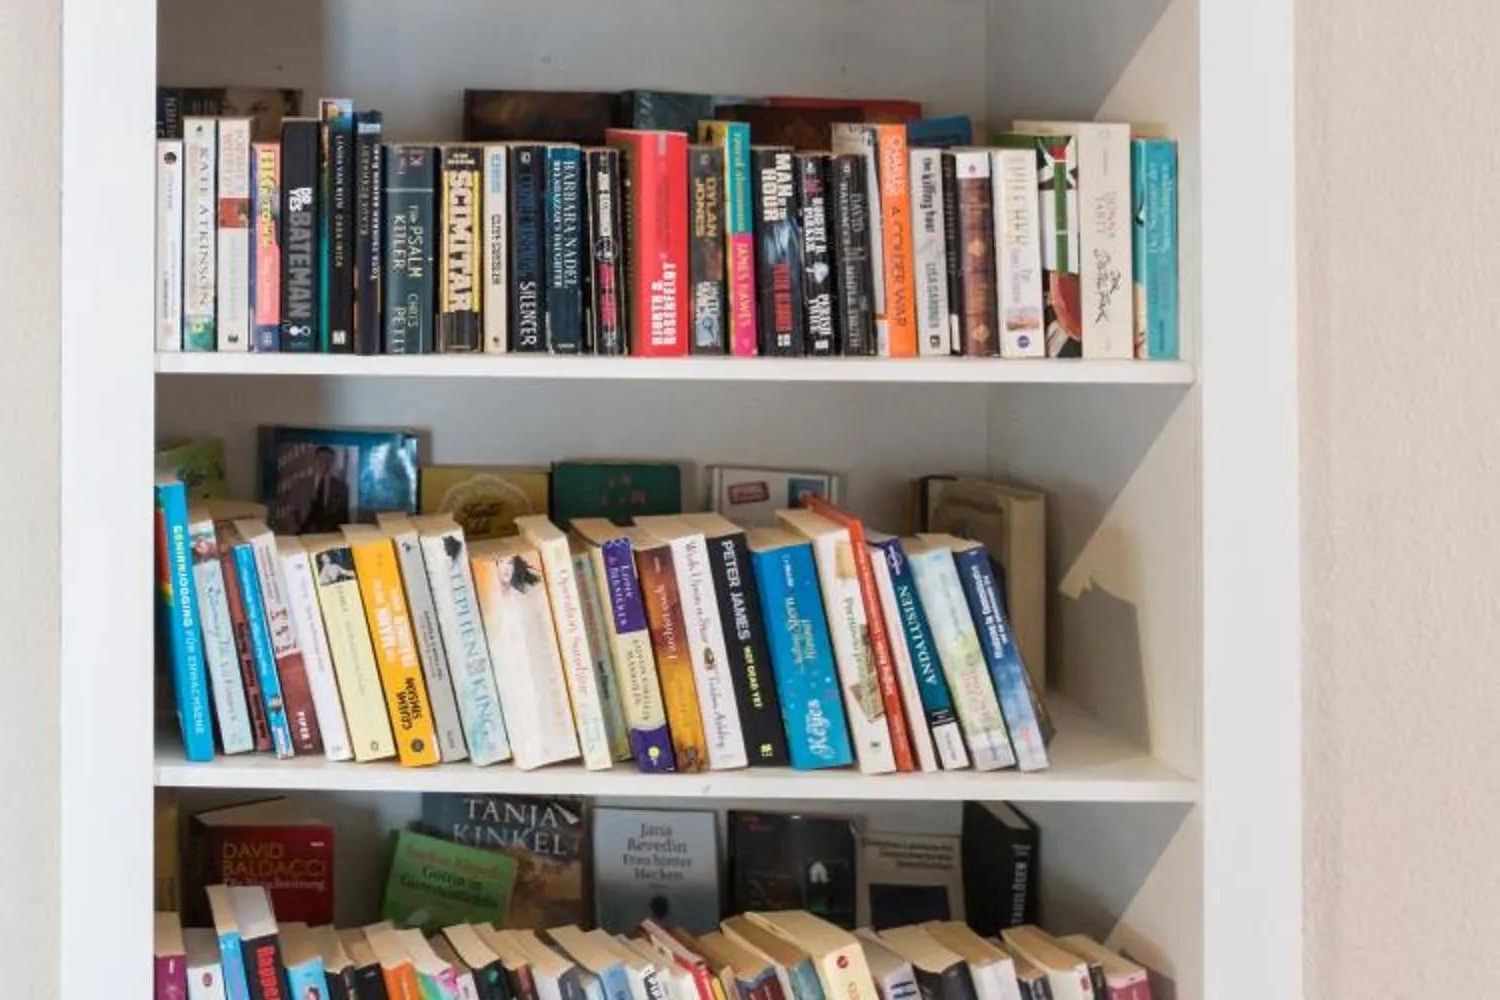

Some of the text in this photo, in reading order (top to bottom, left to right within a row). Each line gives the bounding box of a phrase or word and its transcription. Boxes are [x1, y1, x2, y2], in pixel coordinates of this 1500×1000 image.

[761, 168, 780, 222] HOUR
[775, 153, 793, 197] MAN
[920, 156, 936, 233] the killing hour
[198, 146, 212, 307] KATE ATKINSON
[563, 160, 577, 288] BARBARA NADEL
[695, 177, 706, 237] JONES
[706, 176, 717, 237] DYLAN
[850, 194, 864, 232] DAVID
[290, 212, 312, 317] BATEMAN
[392, 215, 406, 269] KILLER
[407, 226, 423, 277] PSALM
[448, 171, 474, 311] SCIMITAR
[736, 242, 749, 280] JAMES
[926, 263, 937, 284] LISA
[408, 293, 419, 328] CHRIS
[518, 280, 537, 346] SILENCER
[722, 540, 750, 640] PETER JAMES
[449, 561, 494, 732] STEPHEN KING
[898, 585, 937, 685] ANDALUSIEN
[743, 645, 763, 708] NOT DEAD YET
[805, 699, 836, 760] Keyes
[453, 823, 567, 856] KINKEL
[462, 798, 559, 833] TANJA
[222, 842, 284, 860] DAVID
[222, 859, 326, 877] BALDACCI
